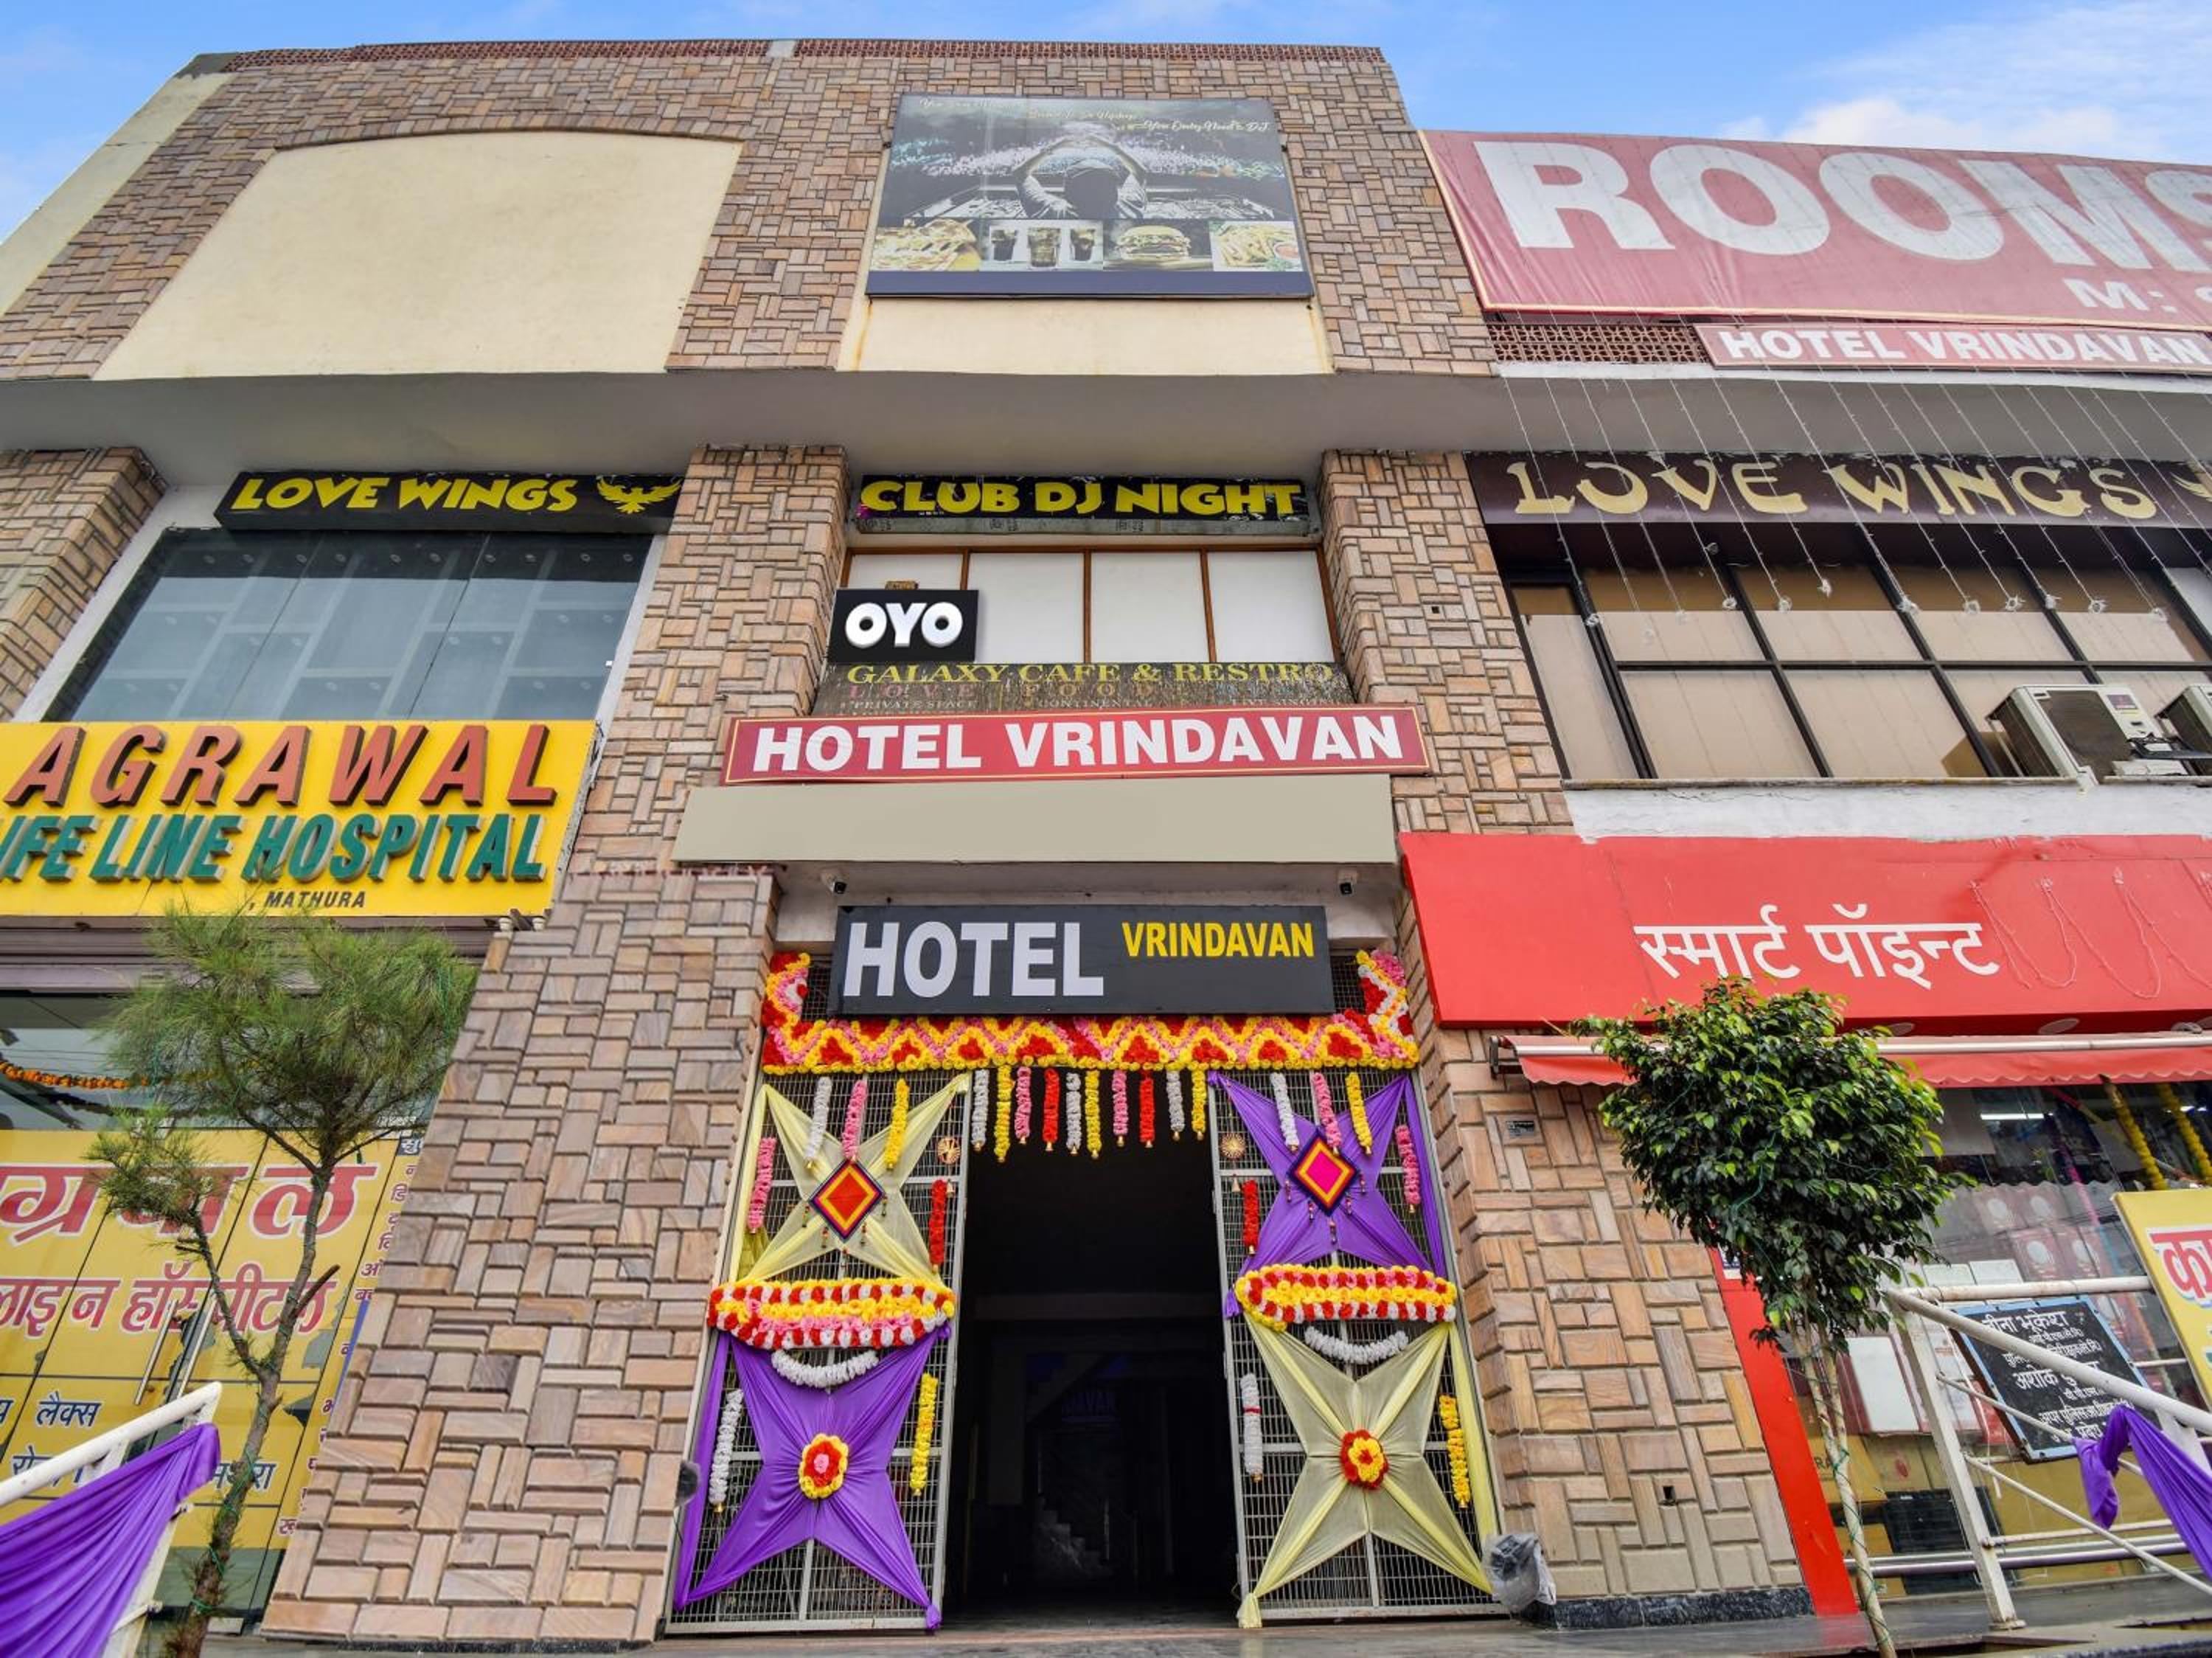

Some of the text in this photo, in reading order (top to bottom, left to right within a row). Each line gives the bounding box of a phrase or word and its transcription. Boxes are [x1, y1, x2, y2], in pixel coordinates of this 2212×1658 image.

[1718, 329, 2212, 365] HOTEL VRINDAVAN
[231, 479, 577, 510] LOVE WINGS
[860, 481, 1301, 515] CLUB DJ NIGHT
[1506, 460, 2156, 519] LOVE WINGS
[844, 602, 963, 648] OYO
[848, 665, 1333, 683] GALAXY CAFE & RESTRO
[4, 724, 558, 808] AGRAWAL
[753, 714, 1404, 772] HOTEL VRINDAVAN
[88, 814, 243, 883] LINE
[240, 813, 549, 883] HOSPITAL
[265, 891, 366, 909] MATHURA
[843, 921, 1315, 997] HOTEL VRINDAVAN
[1634, 903, 2000, 989] स्मार्ट पॉइन्ट
